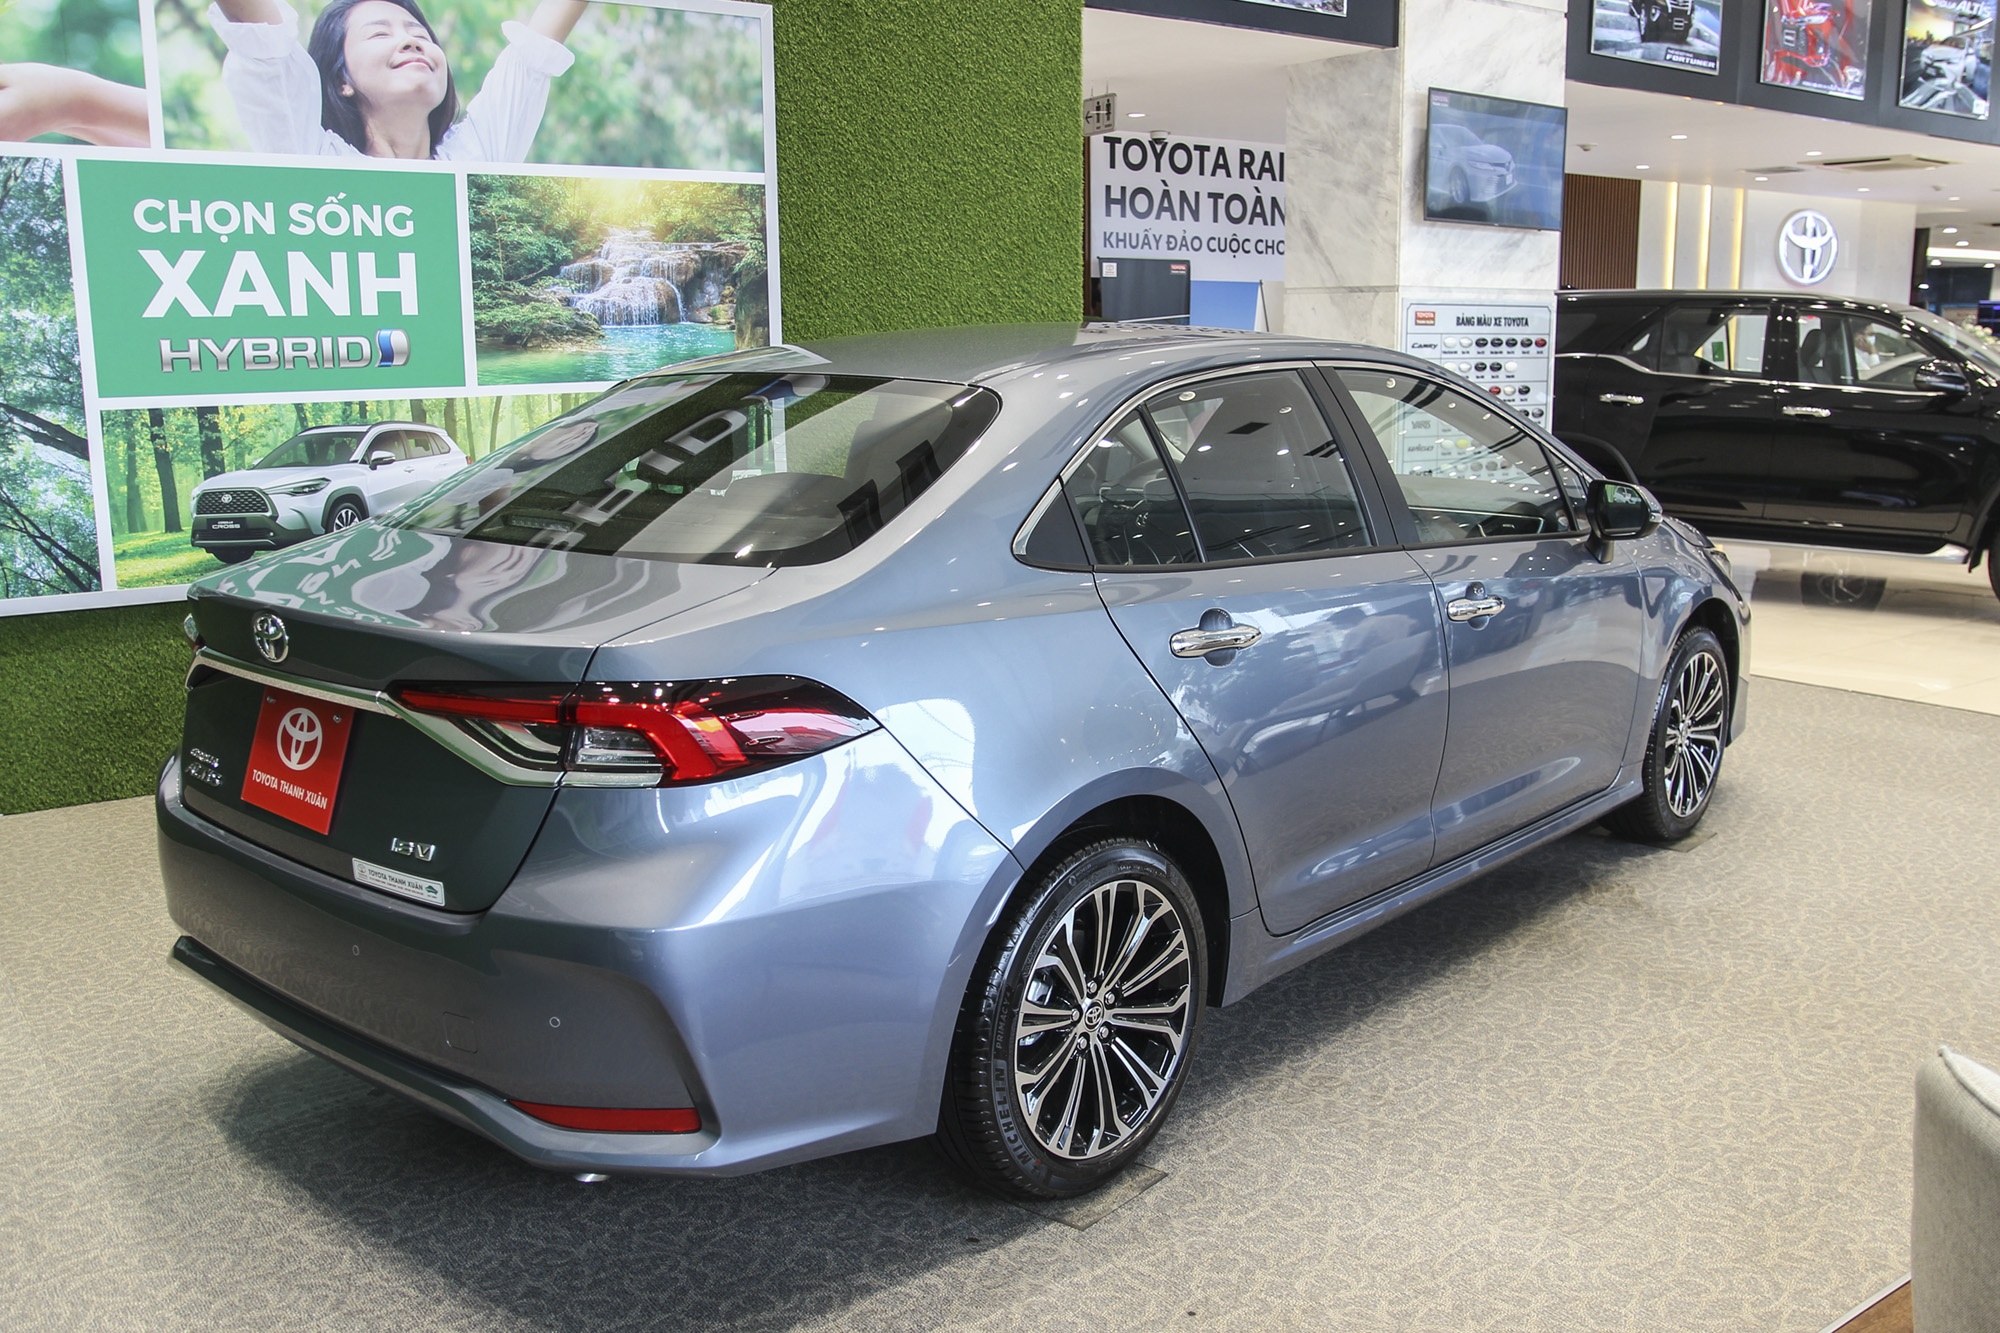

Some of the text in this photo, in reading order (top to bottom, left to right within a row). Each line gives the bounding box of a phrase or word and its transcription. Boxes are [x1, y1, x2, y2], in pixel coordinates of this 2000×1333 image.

[1666, 53, 1716, 69] FORTUNER
[1103, 136, 1231, 179] TOYOTA
[133, 192, 414, 243] CHỌN SỐNG
[1105, 179, 1285, 227] HOÀN TOÀN
[1103, 228, 1163, 251] KHUẤY
[1166, 229, 1203, 252] ĐẢO
[1207, 233, 1251, 258] CUỘC
[138, 249, 419, 318] XANH
[1503, 317, 1529, 328] TOYOTA
[159, 335, 372, 373] HYBRID
[252, 769, 328, 810] TOYOTA THANH XUÂN
[368, 869, 387, 880] TOYOTA
[388, 875, 407, 887] THANH
[994, 1067, 1033, 1165] MICHELIN
